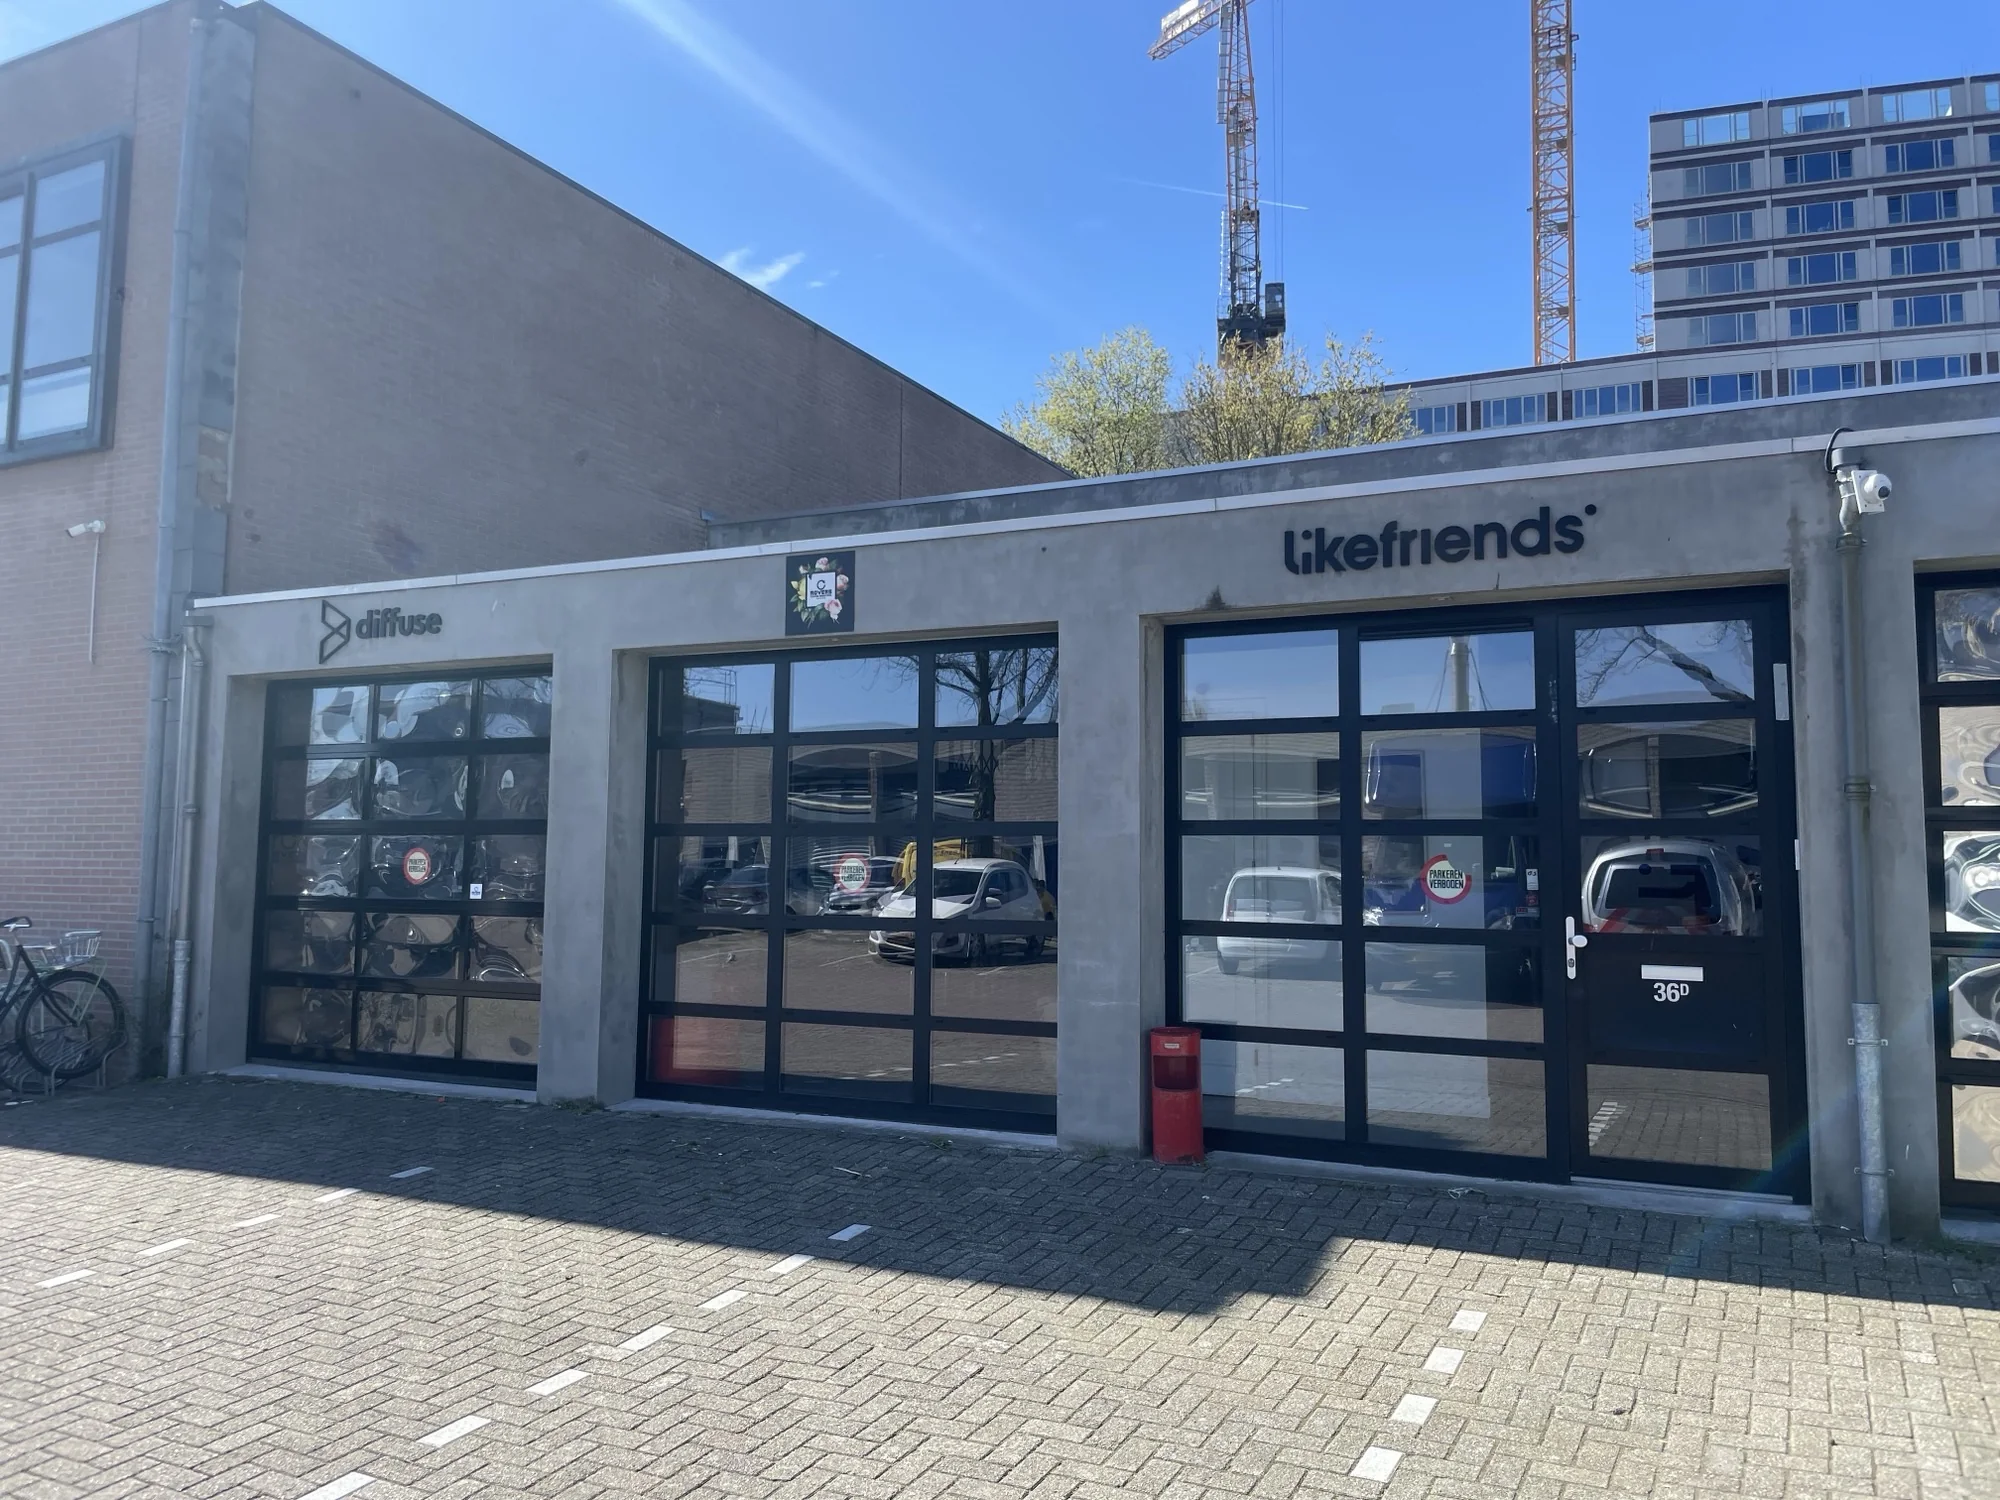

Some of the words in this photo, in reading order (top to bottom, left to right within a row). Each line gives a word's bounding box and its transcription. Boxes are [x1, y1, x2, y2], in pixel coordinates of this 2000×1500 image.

[1284, 503, 1597, 575] likefriends
[355, 606, 443, 640] diffuse
[1429, 869, 1463, 879] PARKEREN
[1429, 880, 1464, 889] VERBODEN
